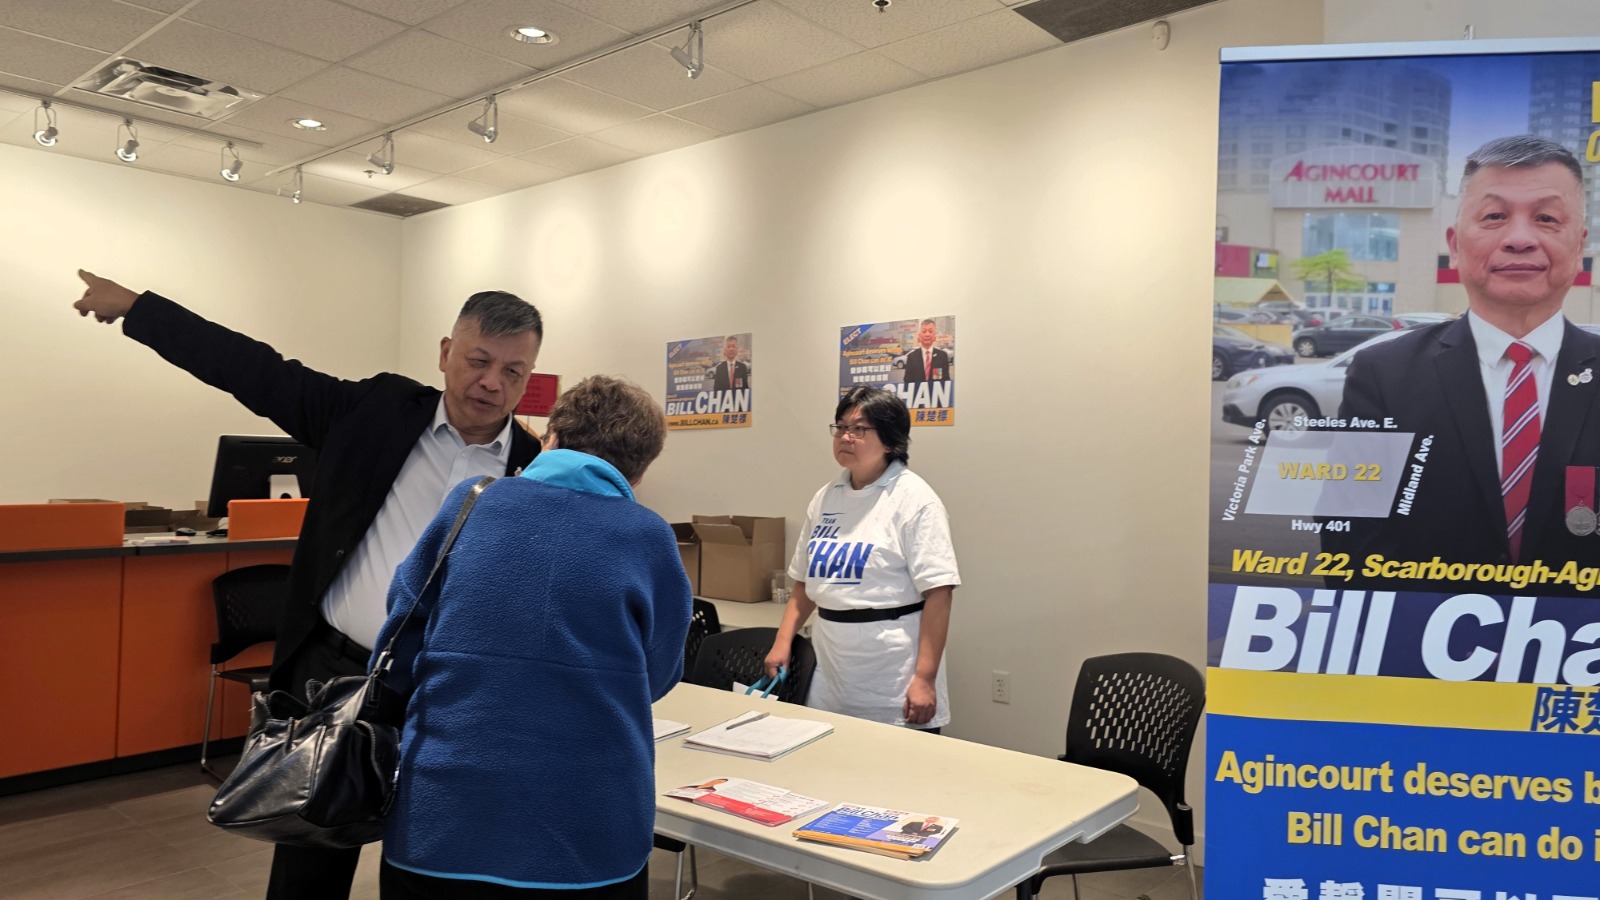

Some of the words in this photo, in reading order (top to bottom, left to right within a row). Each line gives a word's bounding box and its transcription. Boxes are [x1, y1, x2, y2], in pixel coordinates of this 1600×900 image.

[1284, 160, 1421, 182] AGINCOURT
[1324, 186, 1378, 204] MALL
[667, 402, 695, 416] BILL
[695, 389, 750, 414] CHAN
[1293, 416, 1347, 428] Steeles
[1350, 417, 1380, 429] Ave.
[1383, 418, 1398, 429] E.
[1222, 476, 1247, 522] Victoria
[1239, 445, 1257, 474] Park
[1248, 418, 1266, 445] Ave.
[1278, 462, 1348, 481] WARD
[1354, 464, 1382, 481] 22
[1397, 464, 1424, 516] Midland
[1416, 434, 1434, 463] Ave.
[811, 526, 840, 539] BILL
[1291, 520, 1323, 533] Hwy
[1325, 521, 1350, 532] 401
[1232, 549, 1308, 575] Ward
[1311, 553, 1355, 581] 22,
[1219, 586, 1396, 676] Bill
[1215, 751, 1393, 794] Agincourt
[1403, 763, 1573, 802] deserves
[1287, 812, 1342, 845] Bill
[1353, 815, 1447, 852] Chan
[1458, 830, 1526, 857] can
[1536, 827, 1583, 861] do
